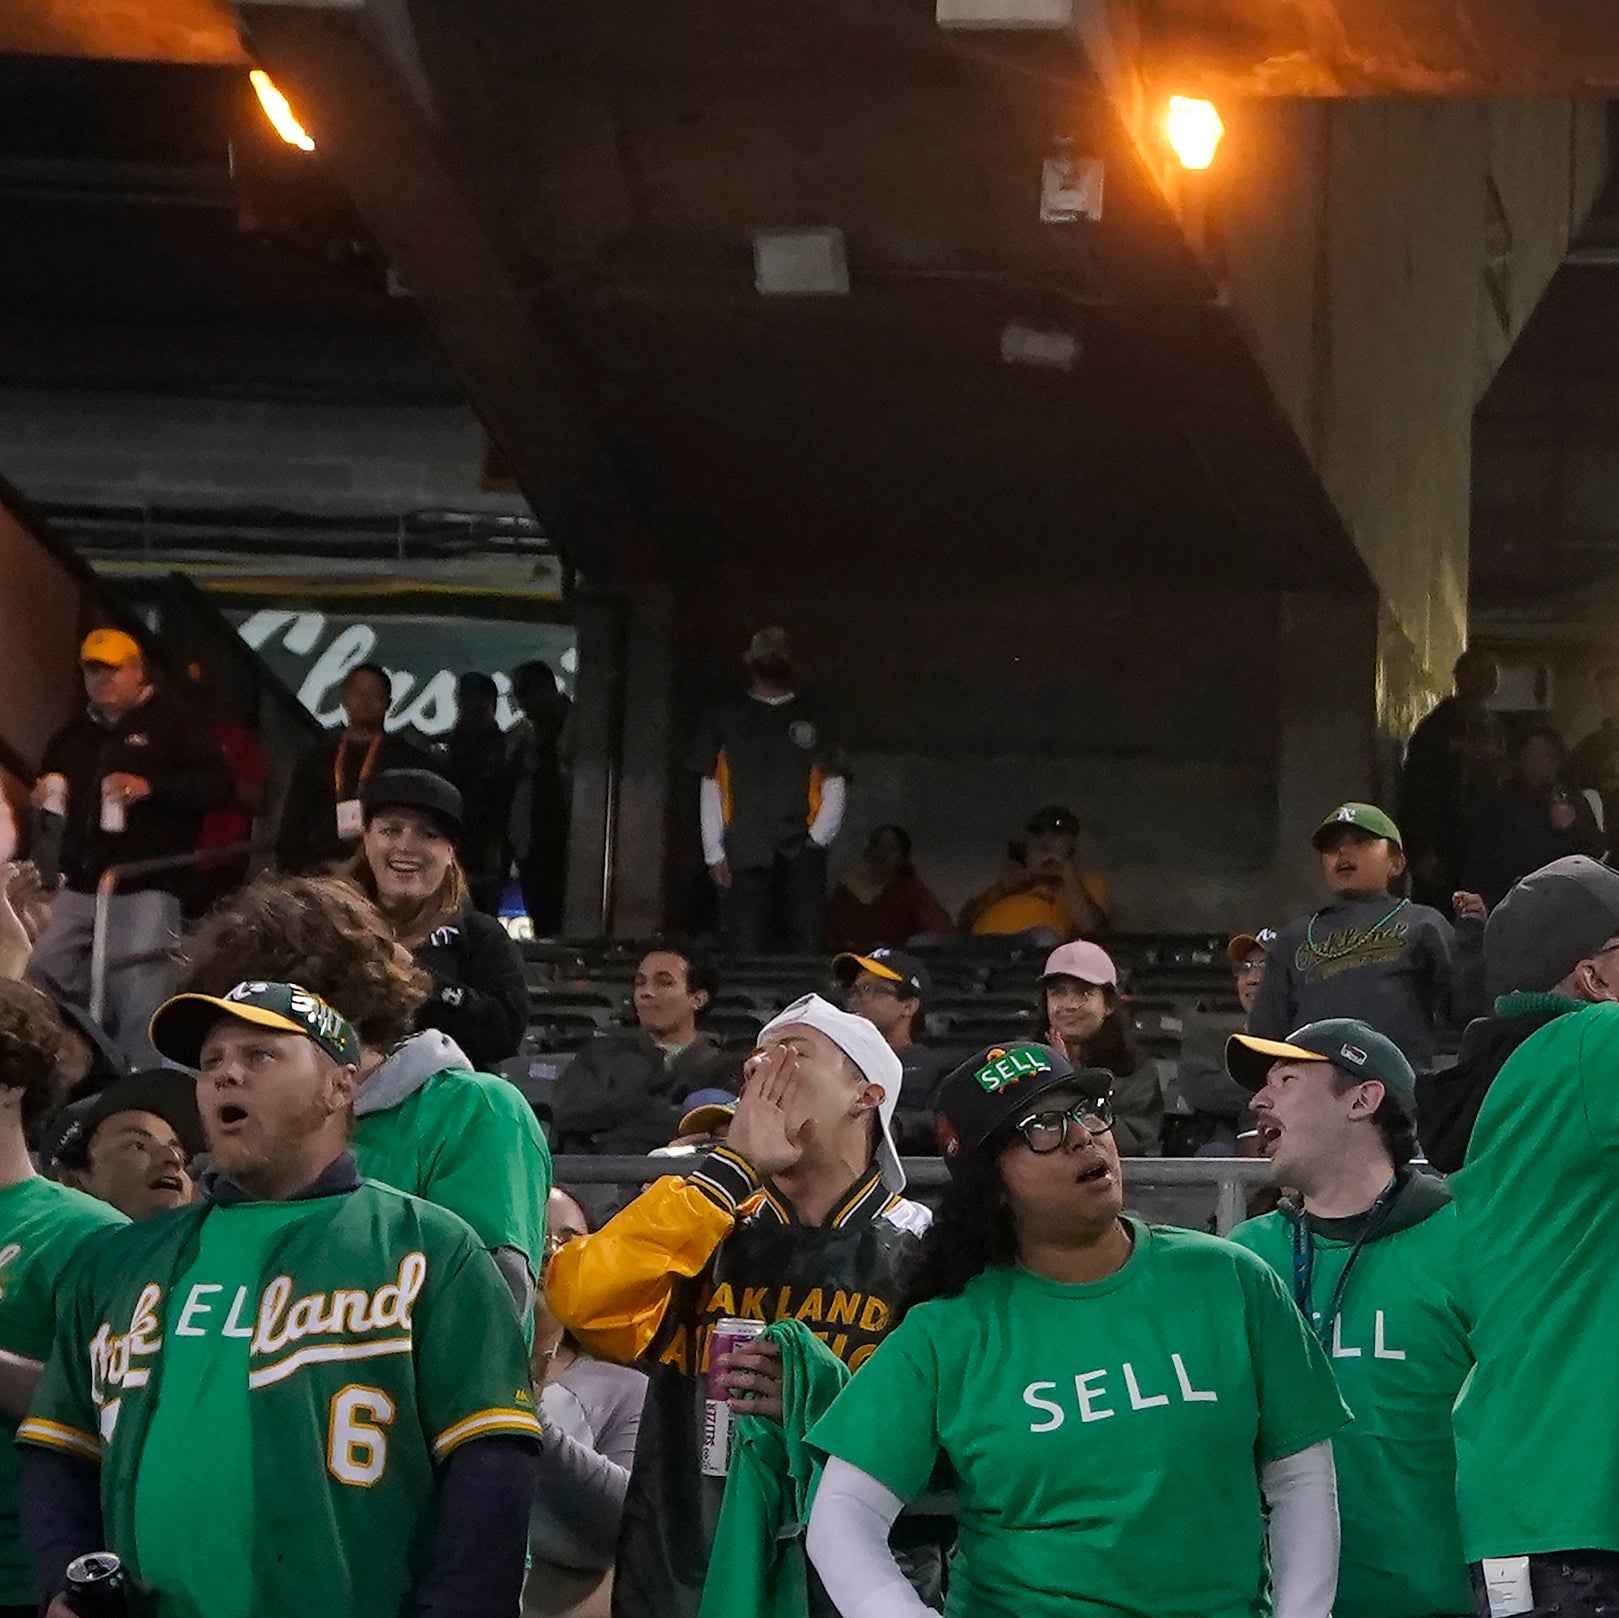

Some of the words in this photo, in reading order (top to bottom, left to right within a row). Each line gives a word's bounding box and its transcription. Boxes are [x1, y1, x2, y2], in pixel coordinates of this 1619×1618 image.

[981, 1052, 1046, 1091] SELL
[176, 1284, 255, 1338] EL
[1023, 1353, 1218, 1432] SELL
[328, 1383, 396, 1487] 6
